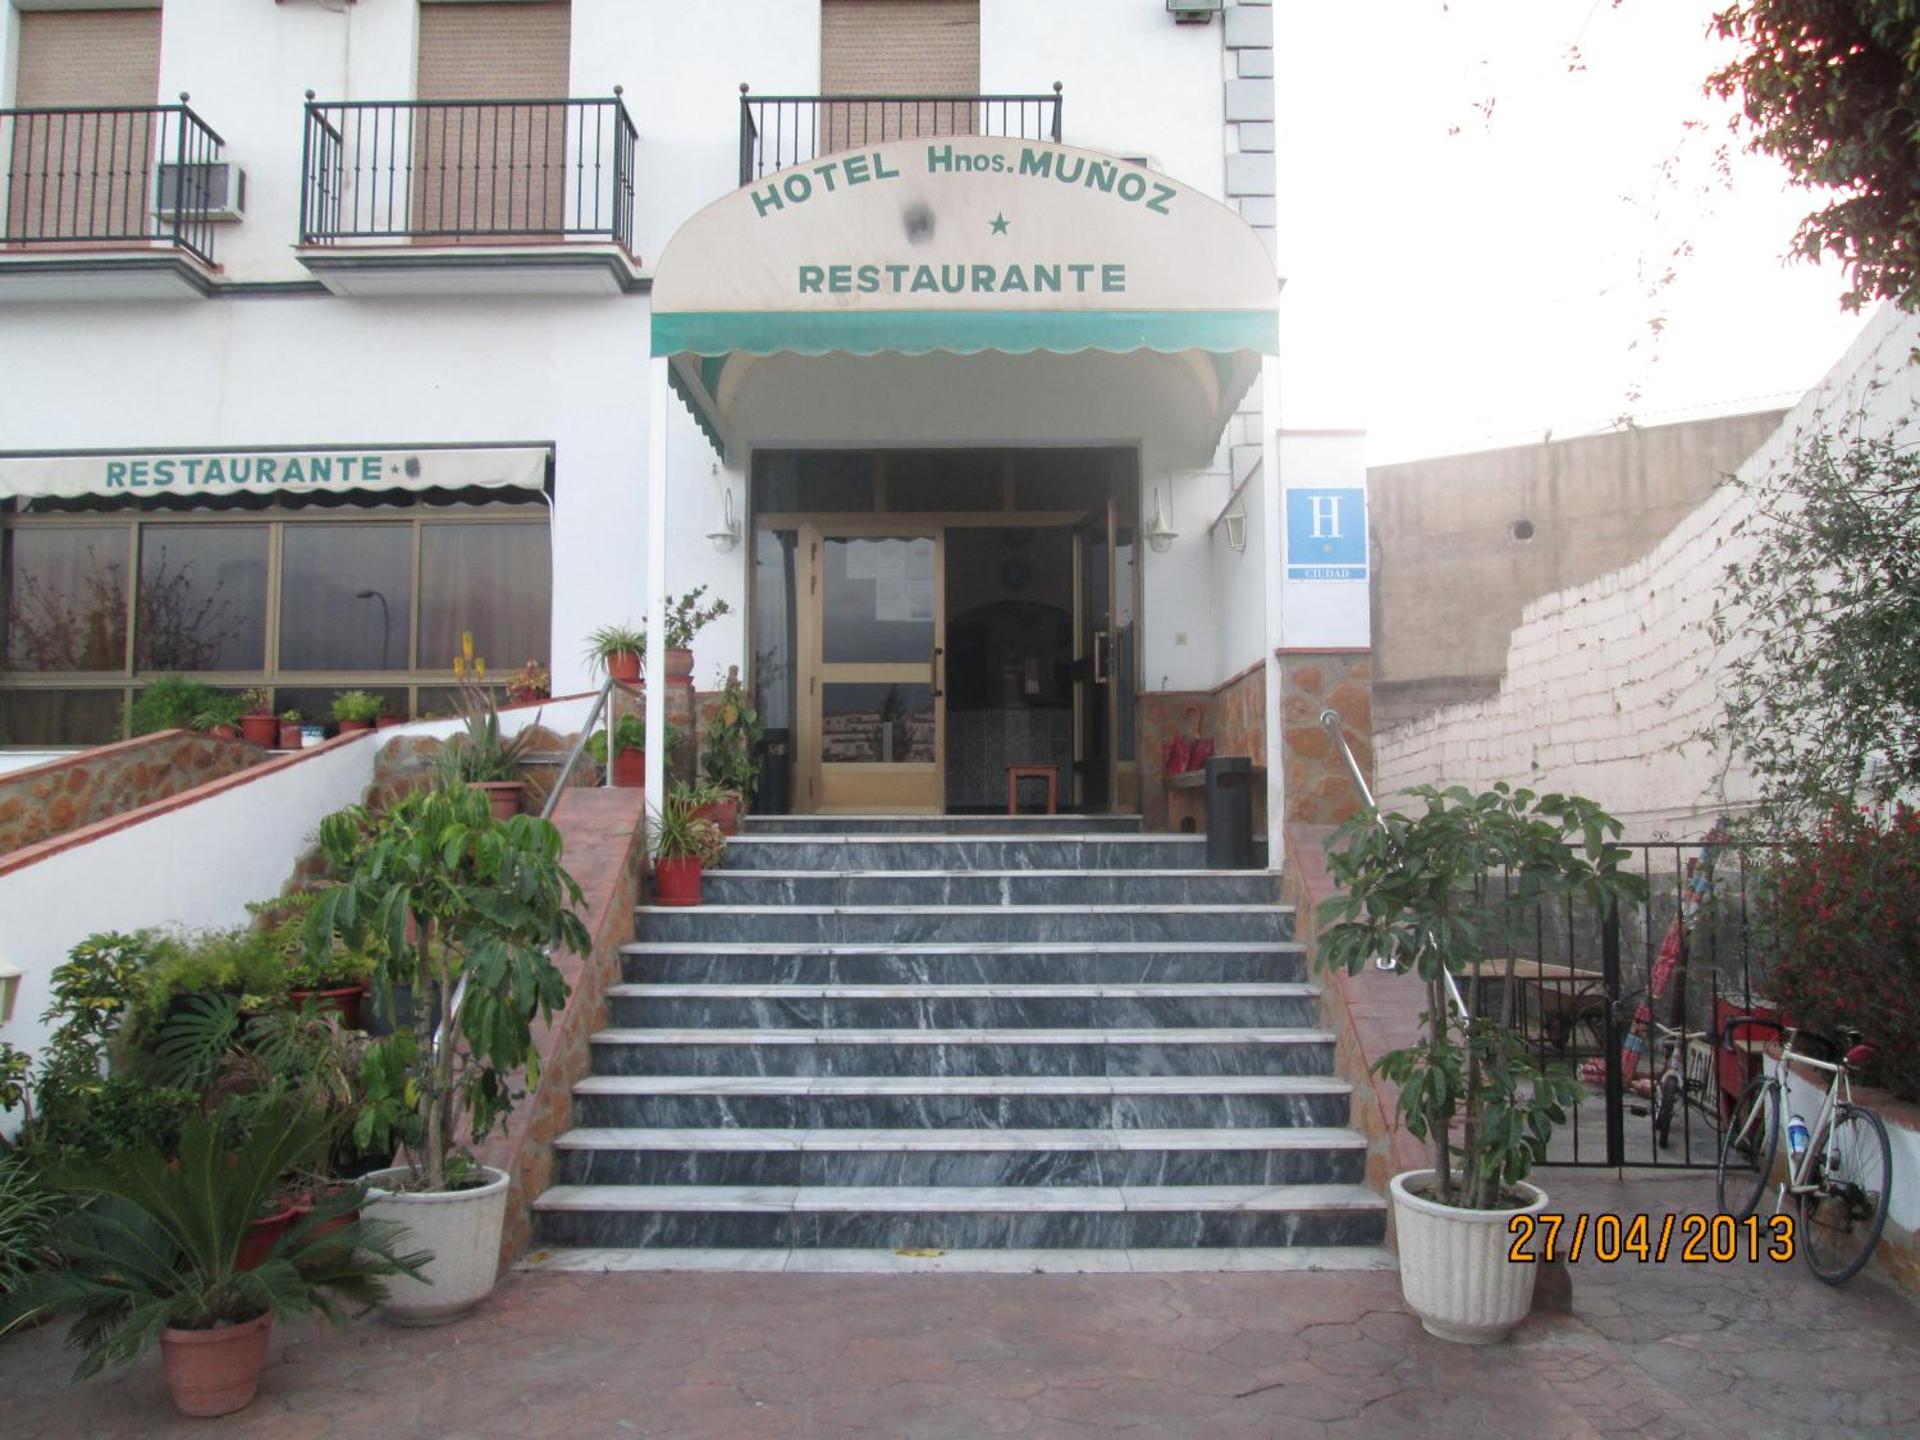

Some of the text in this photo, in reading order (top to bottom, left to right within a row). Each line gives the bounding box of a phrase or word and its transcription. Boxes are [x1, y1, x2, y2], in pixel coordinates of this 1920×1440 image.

[750, 144, 1178, 217] HOTEL Hnos. MUÑOZ
[799, 263, 1127, 293] RESTAURANTE
[106, 456, 383, 487] RESTAURANTE
[1307, 495, 1343, 538] H
[1305, 568, 1350, 578] CIUDAD
